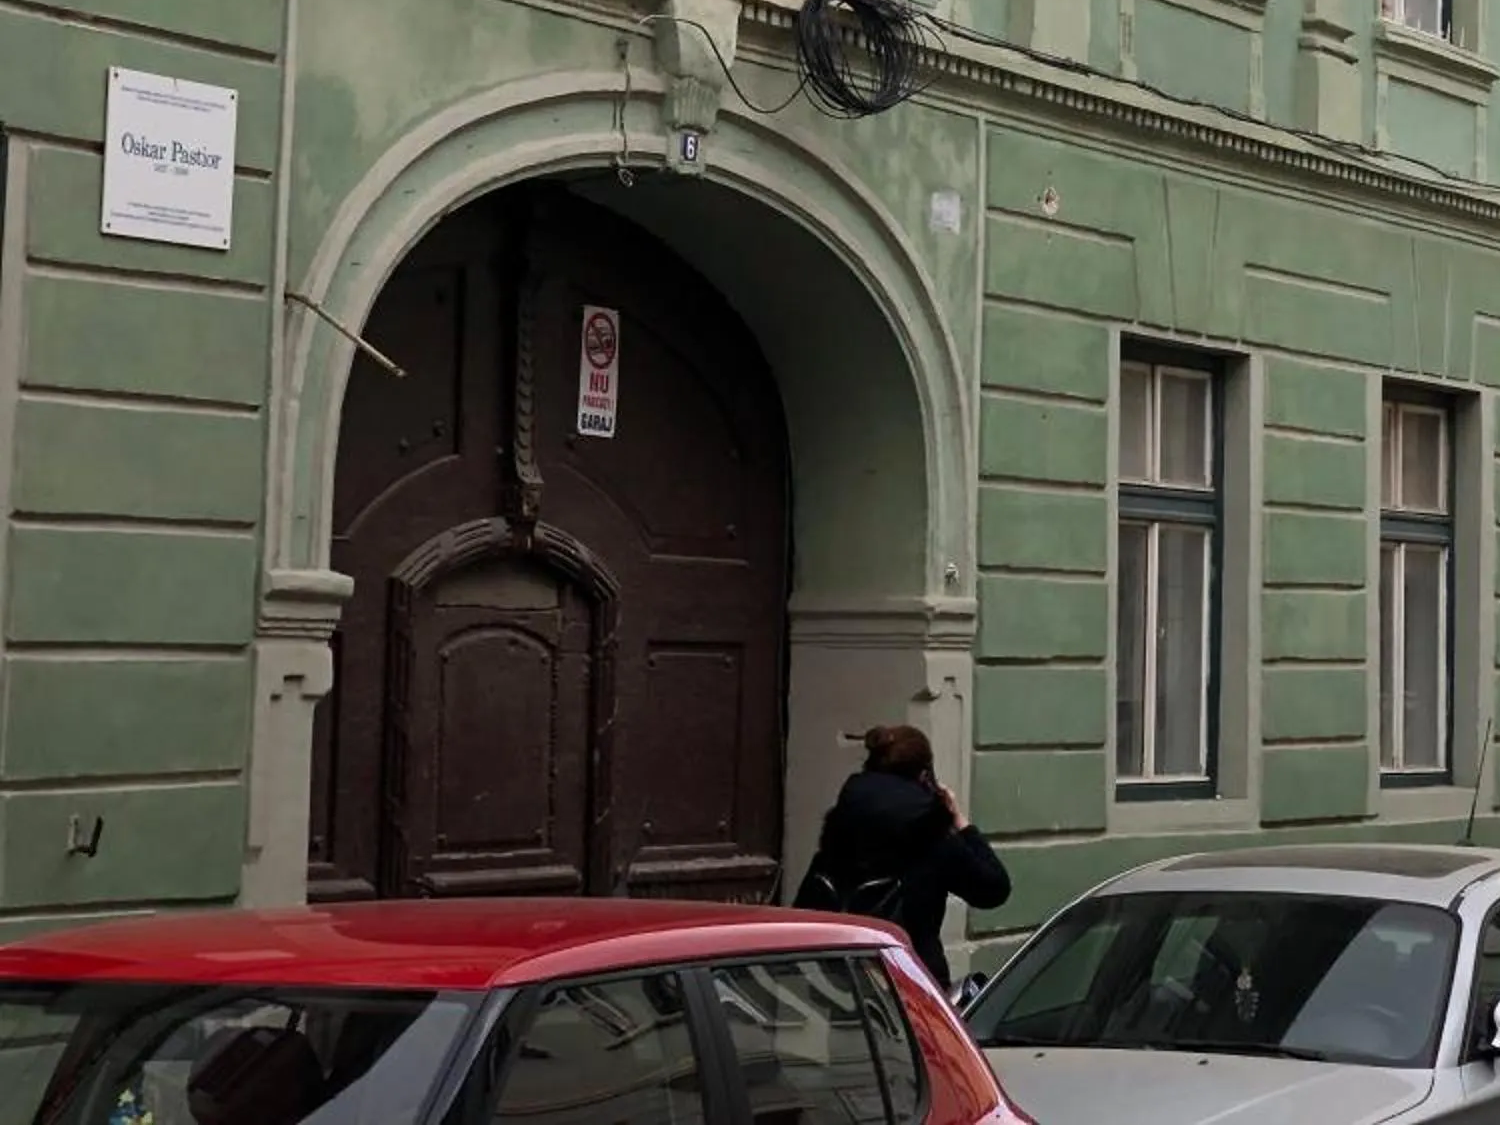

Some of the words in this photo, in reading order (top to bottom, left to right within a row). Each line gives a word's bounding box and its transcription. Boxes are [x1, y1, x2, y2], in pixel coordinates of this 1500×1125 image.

[121, 132, 167, 161] Oskar
[171, 140, 222, 169] Pastior
[687, 136, 695, 160] 6
[589, 372, 609, 393] NU
[581, 412, 613, 433] GARAJ
